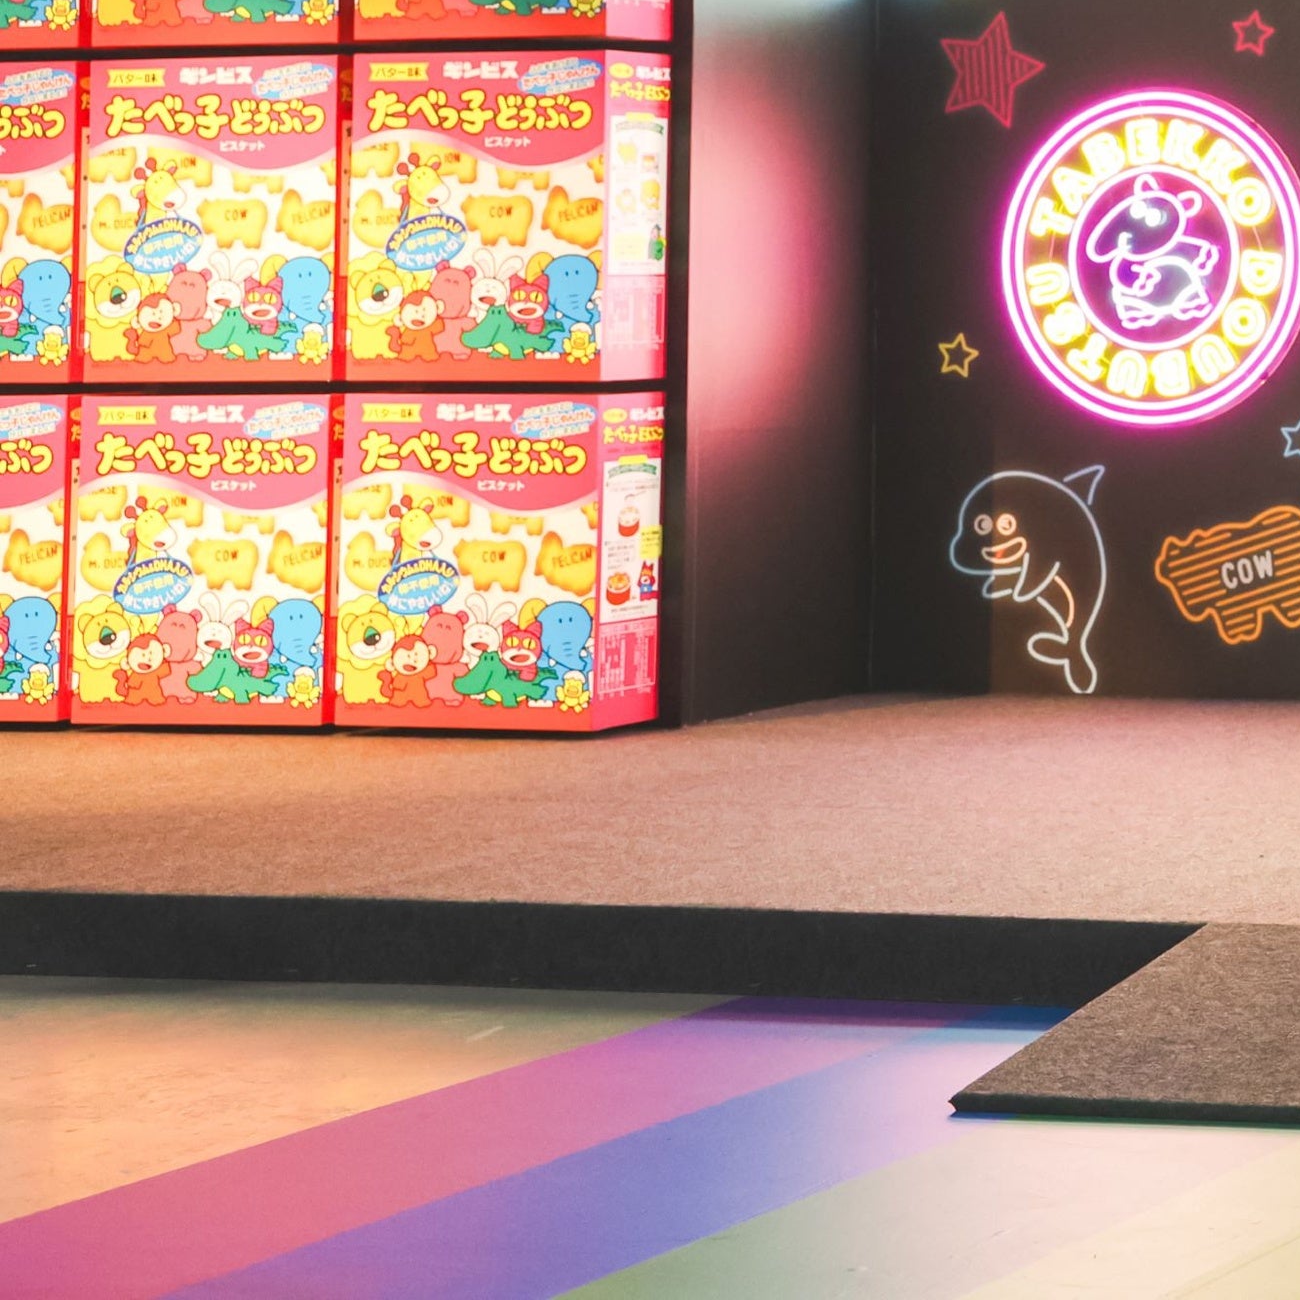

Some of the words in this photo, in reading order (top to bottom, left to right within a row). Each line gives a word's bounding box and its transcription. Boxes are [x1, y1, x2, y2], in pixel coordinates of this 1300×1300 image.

[180, 65, 253, 86] ギンビス
[443, 59, 519, 81] ギンビス
[105, 94, 325, 141] たべっ子どうぶつ
[367, 89, 592, 137] たべっ子どうぶつ
[220, 140, 265, 153] ビスケット
[484, 136, 531, 149] ビスケット
[1029, 118, 1272, 237] TABEKKO
[224, 208, 248, 221] COW
[488, 205, 513, 217] COW
[1025, 249, 1284, 398] DOUBUTSU
[171, 403, 245, 425] ギンビス
[436, 401, 512, 423] ギンビス
[96, 433, 317, 480] たべっ子どうぶつ
[359, 432, 587, 480] たべっ子どうぶつ
[211, 480, 257, 492] ビスケット
[478, 480, 525, 493] ビスケット
[214, 549, 239, 561] COW
[481, 550, 506, 562] COW
[1220, 551, 1274, 590] COW
